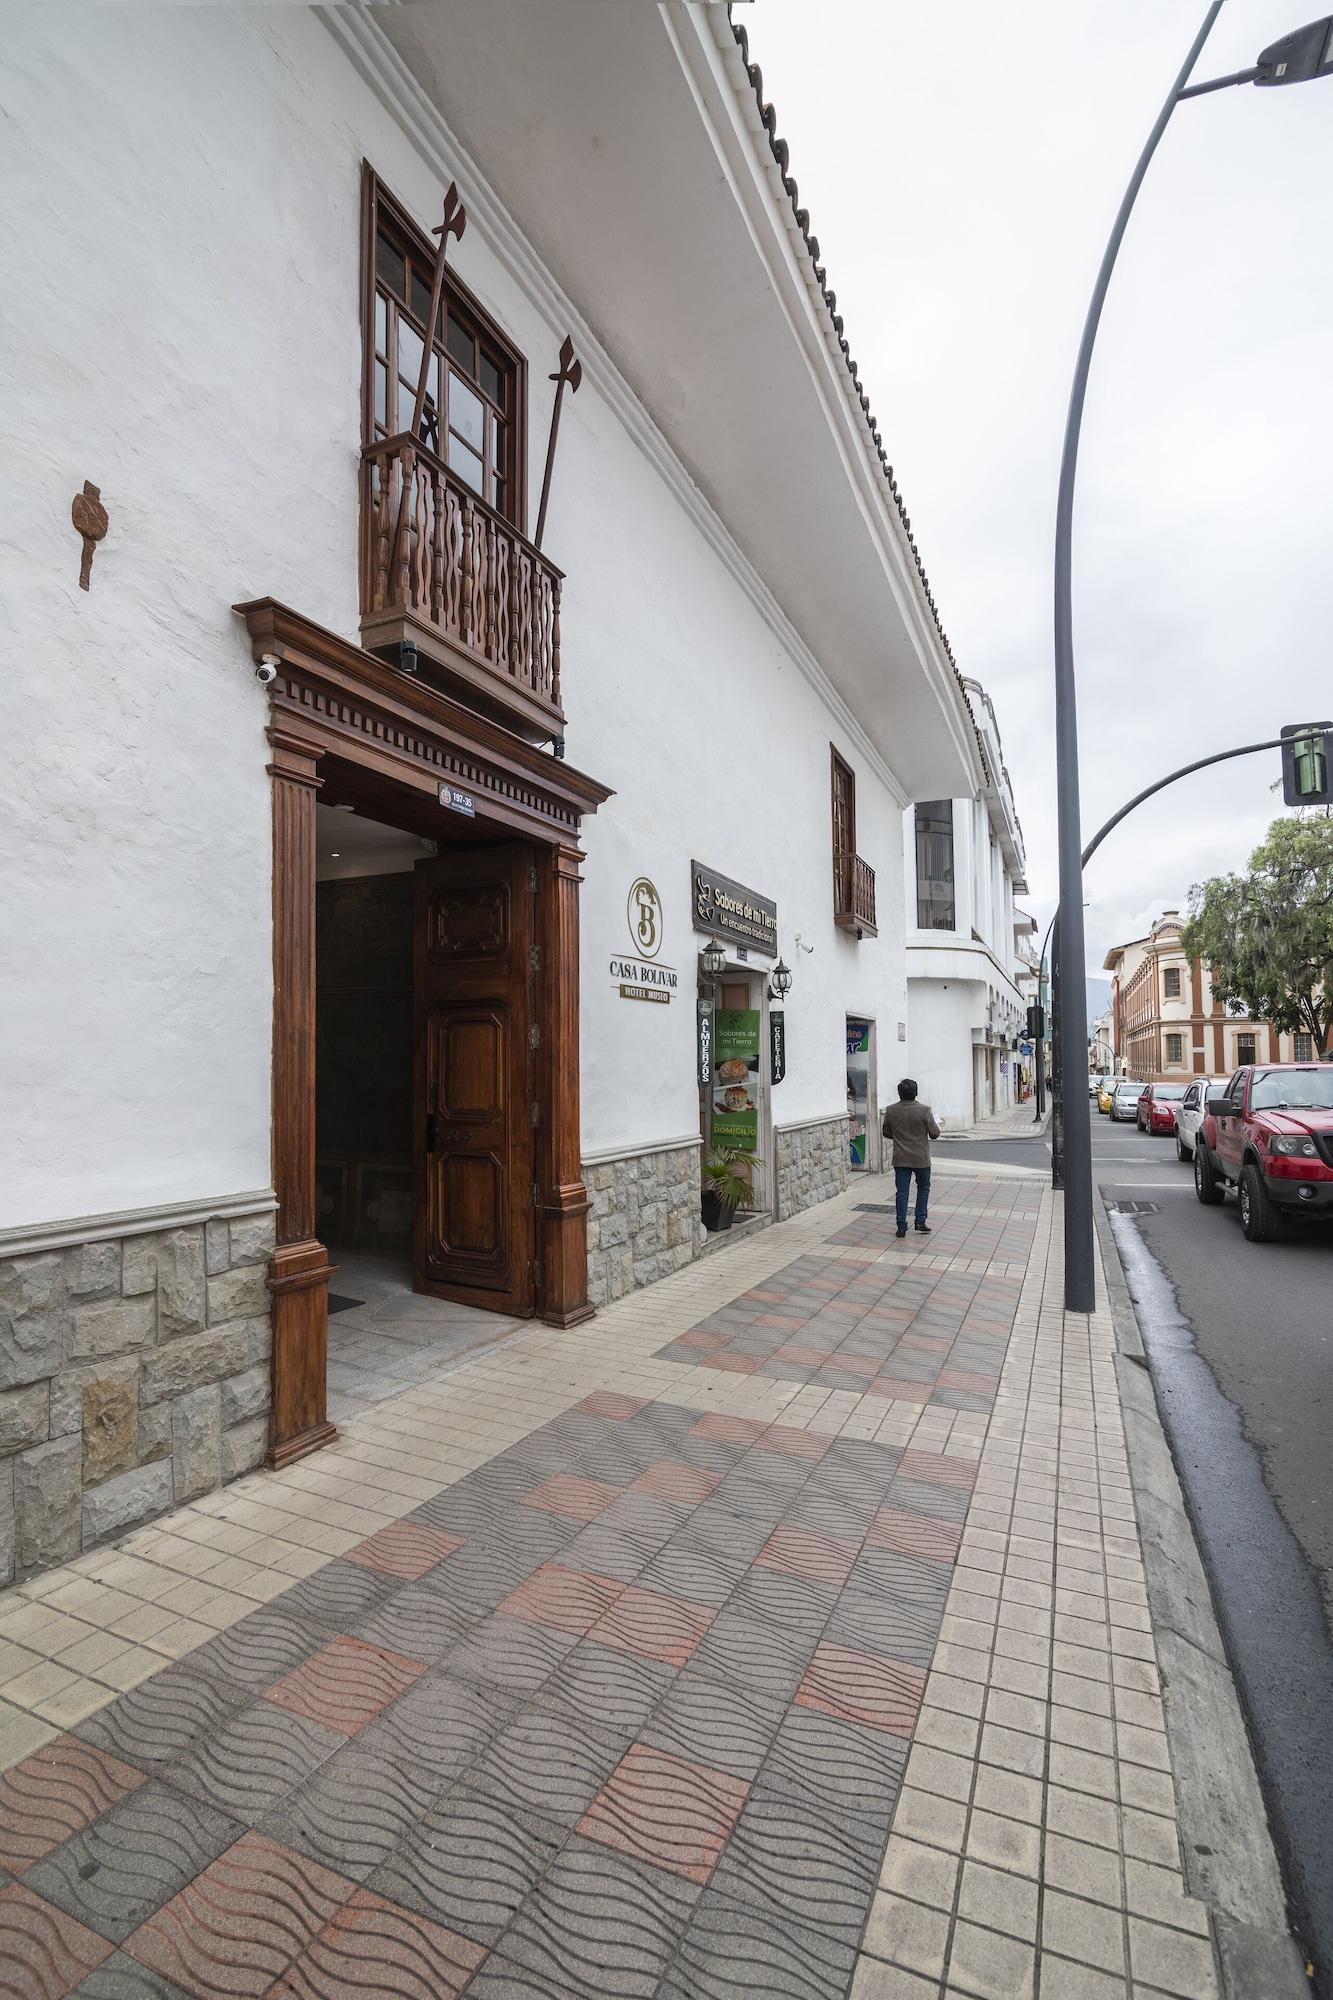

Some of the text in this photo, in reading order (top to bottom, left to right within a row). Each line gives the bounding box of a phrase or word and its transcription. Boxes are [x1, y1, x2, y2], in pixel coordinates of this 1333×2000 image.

[715, 888, 743, 916] Sabores
[744, 903, 753, 920] de
[753, 908, 761, 924] mi
[720, 913, 728, 926] Un
[729, 920, 752, 935] encuentro
[610, 961, 678, 987] CASA BOLIVAR
[625, 987, 668, 1001] HOTEL MUSEO
[719, 1029, 746, 1037] Sabores
[732, 1038, 752, 1046] Tierra
[701, 1018, 711, 1082] ALMUERZOS
[713, 1126, 757, 1136] DOMICILIO
